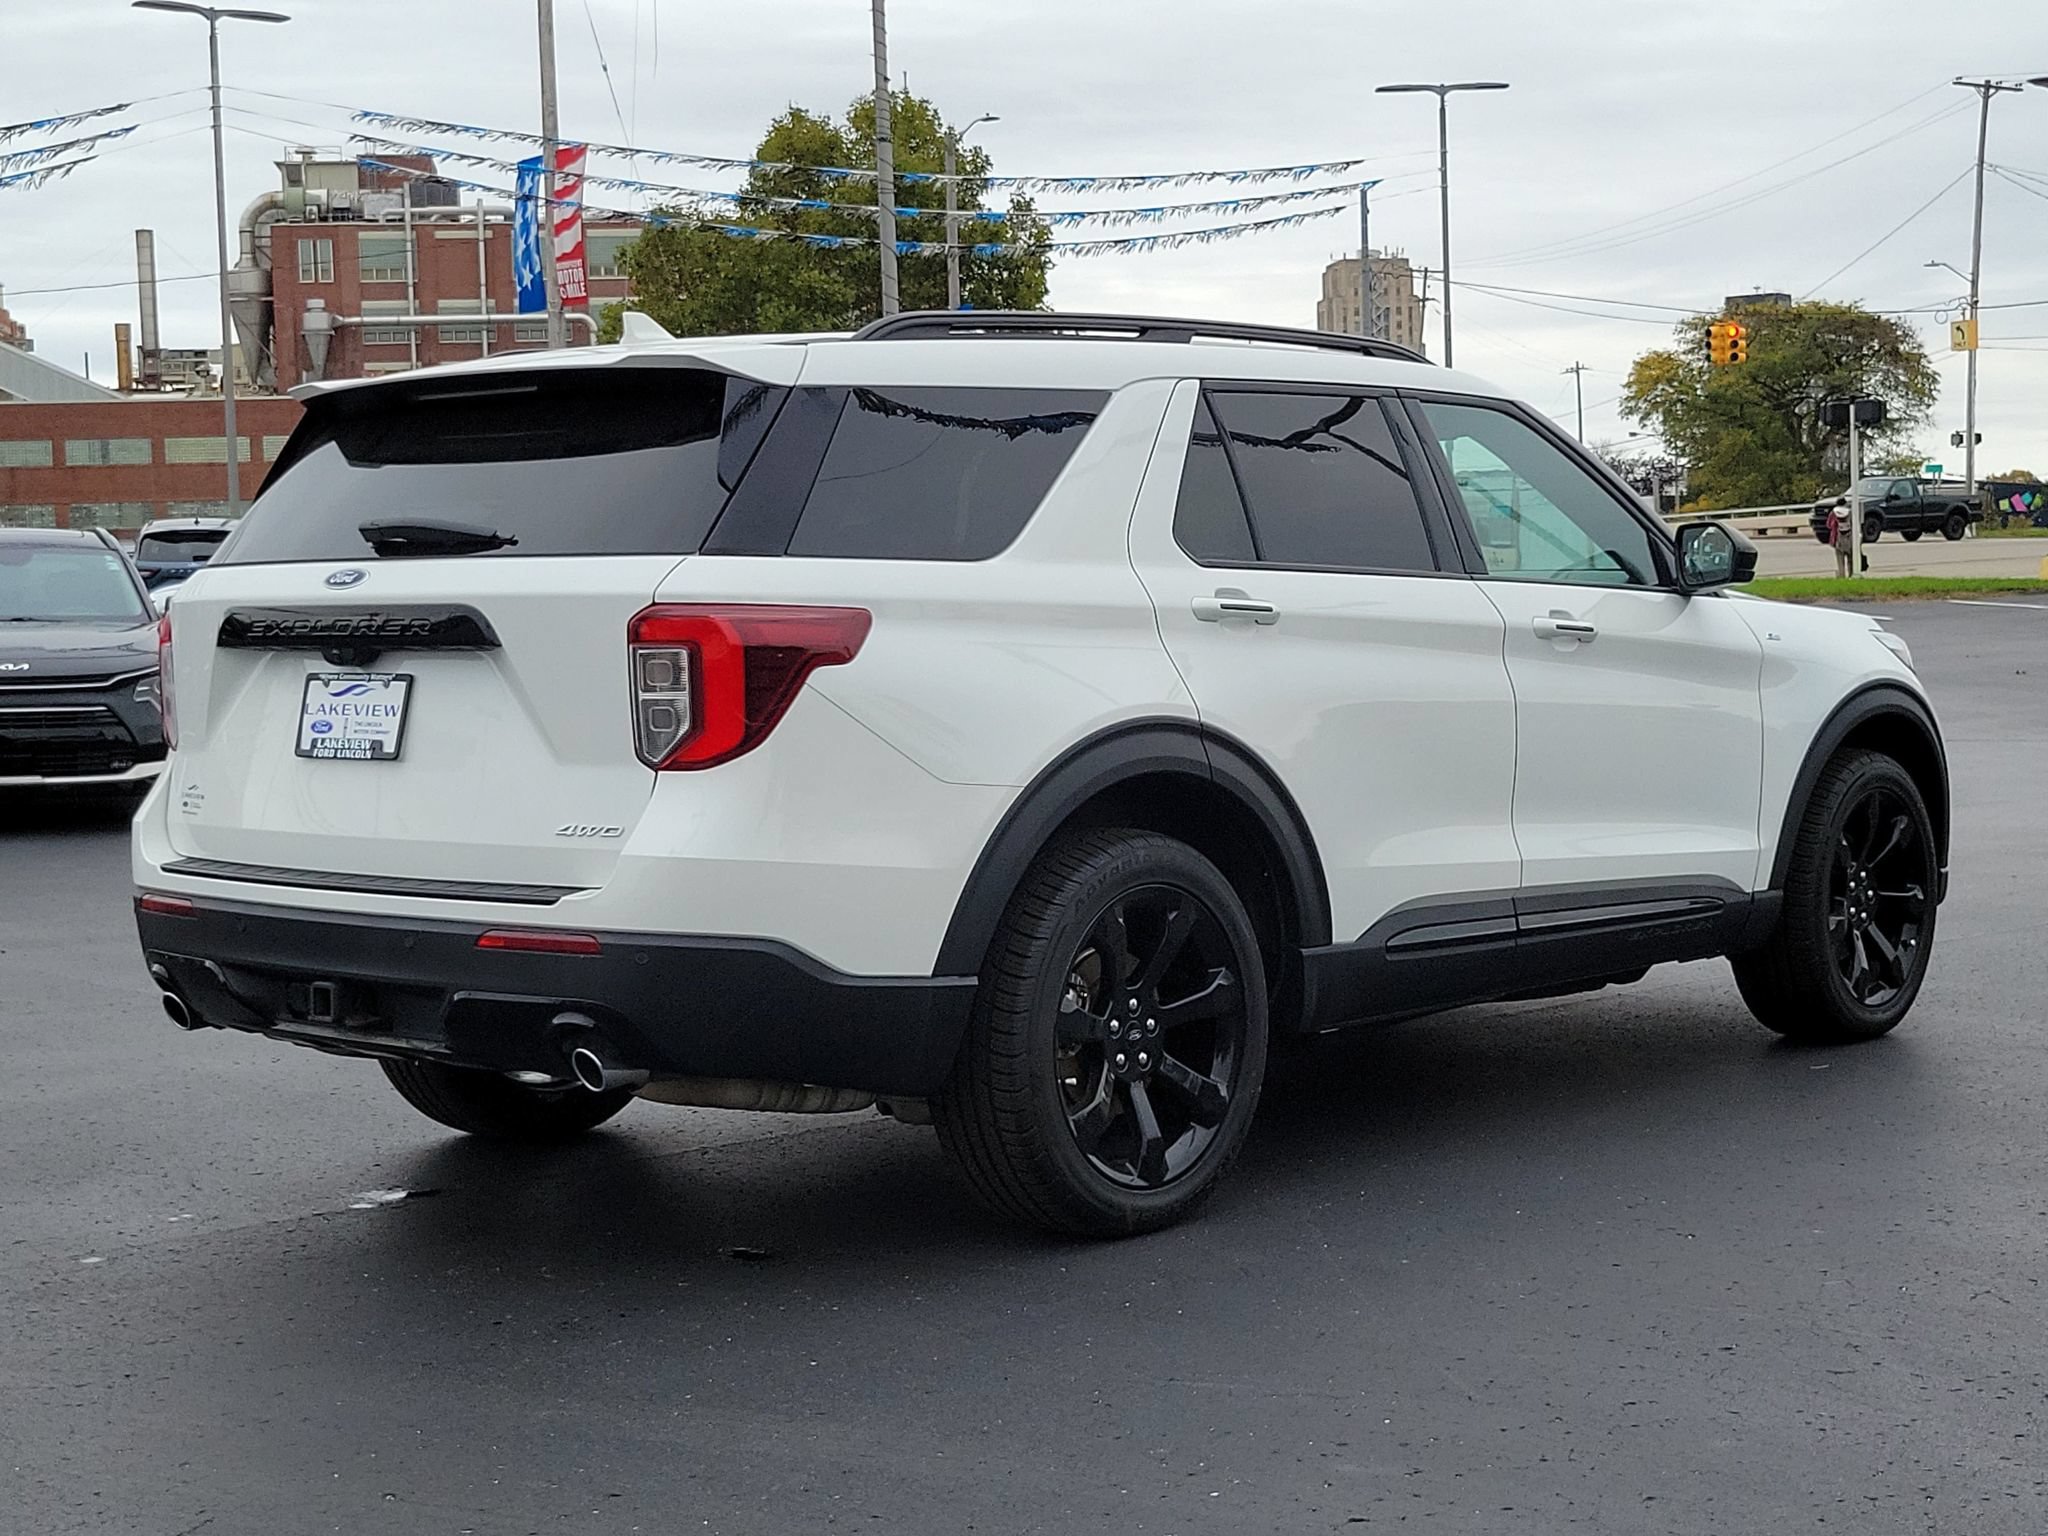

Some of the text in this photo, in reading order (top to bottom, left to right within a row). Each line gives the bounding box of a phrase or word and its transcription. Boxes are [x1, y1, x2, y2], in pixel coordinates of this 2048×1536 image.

[557, 267, 584, 285] MOTOR
[248, 618, 432, 636] EXPLORER
[305, 703, 400, 717] LAKEVIEW
[316, 738, 373, 749] LAKEVIEW
[313, 748, 374, 759] FORD LINCOLN
[555, 824, 625, 838] 4WD
